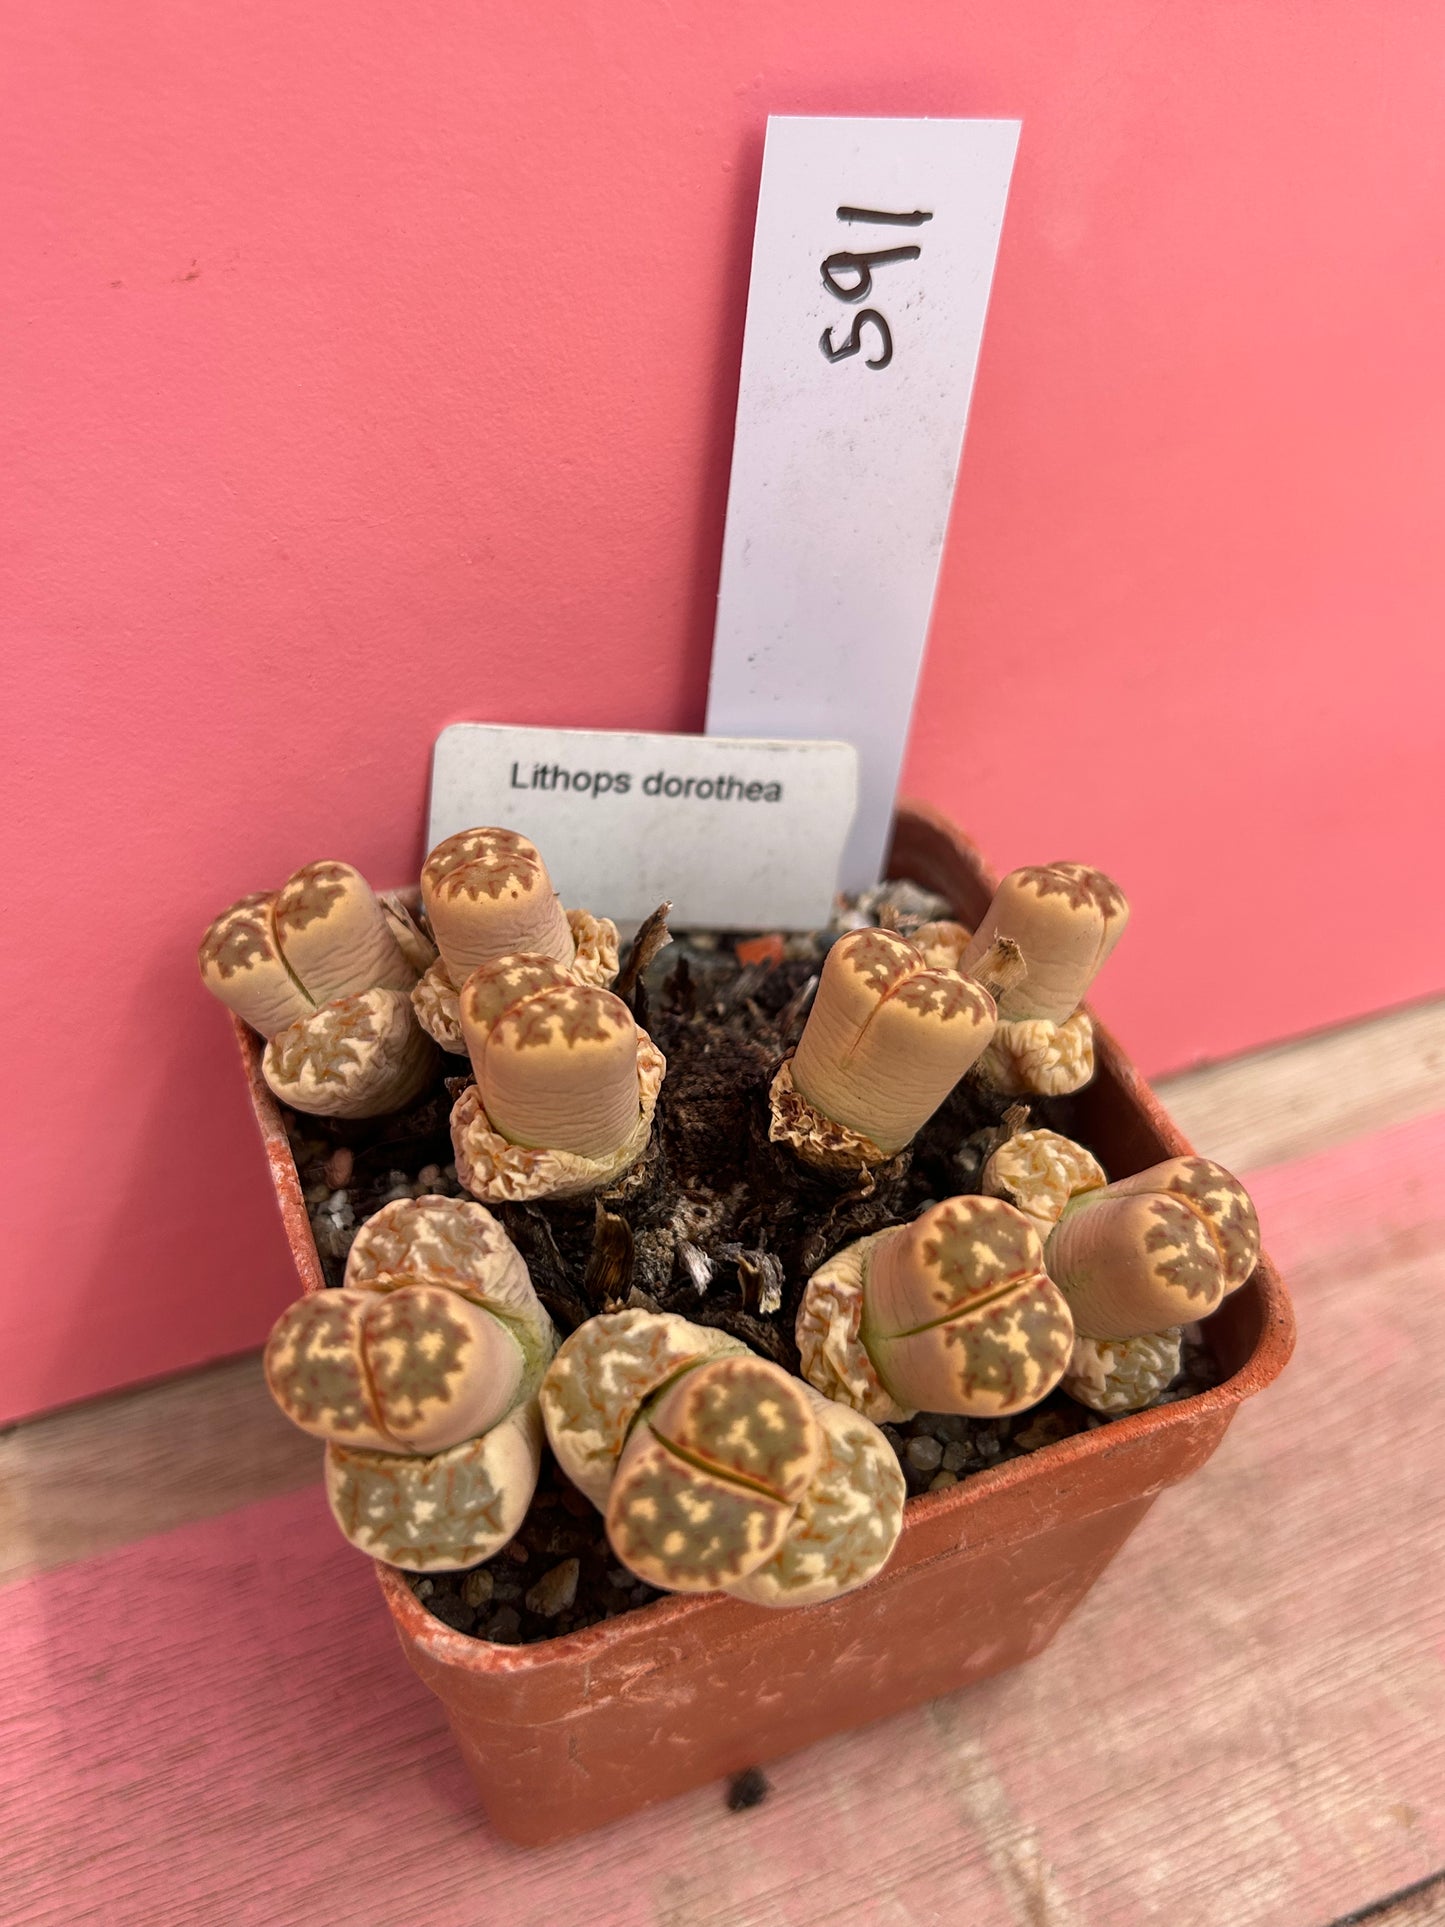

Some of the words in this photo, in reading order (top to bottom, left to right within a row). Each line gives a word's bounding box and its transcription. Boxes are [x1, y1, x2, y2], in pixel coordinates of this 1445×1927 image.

[818, 206, 933, 371] 591
[511, 761, 632, 798] Lithops
[642, 770, 783, 803] dorothea
